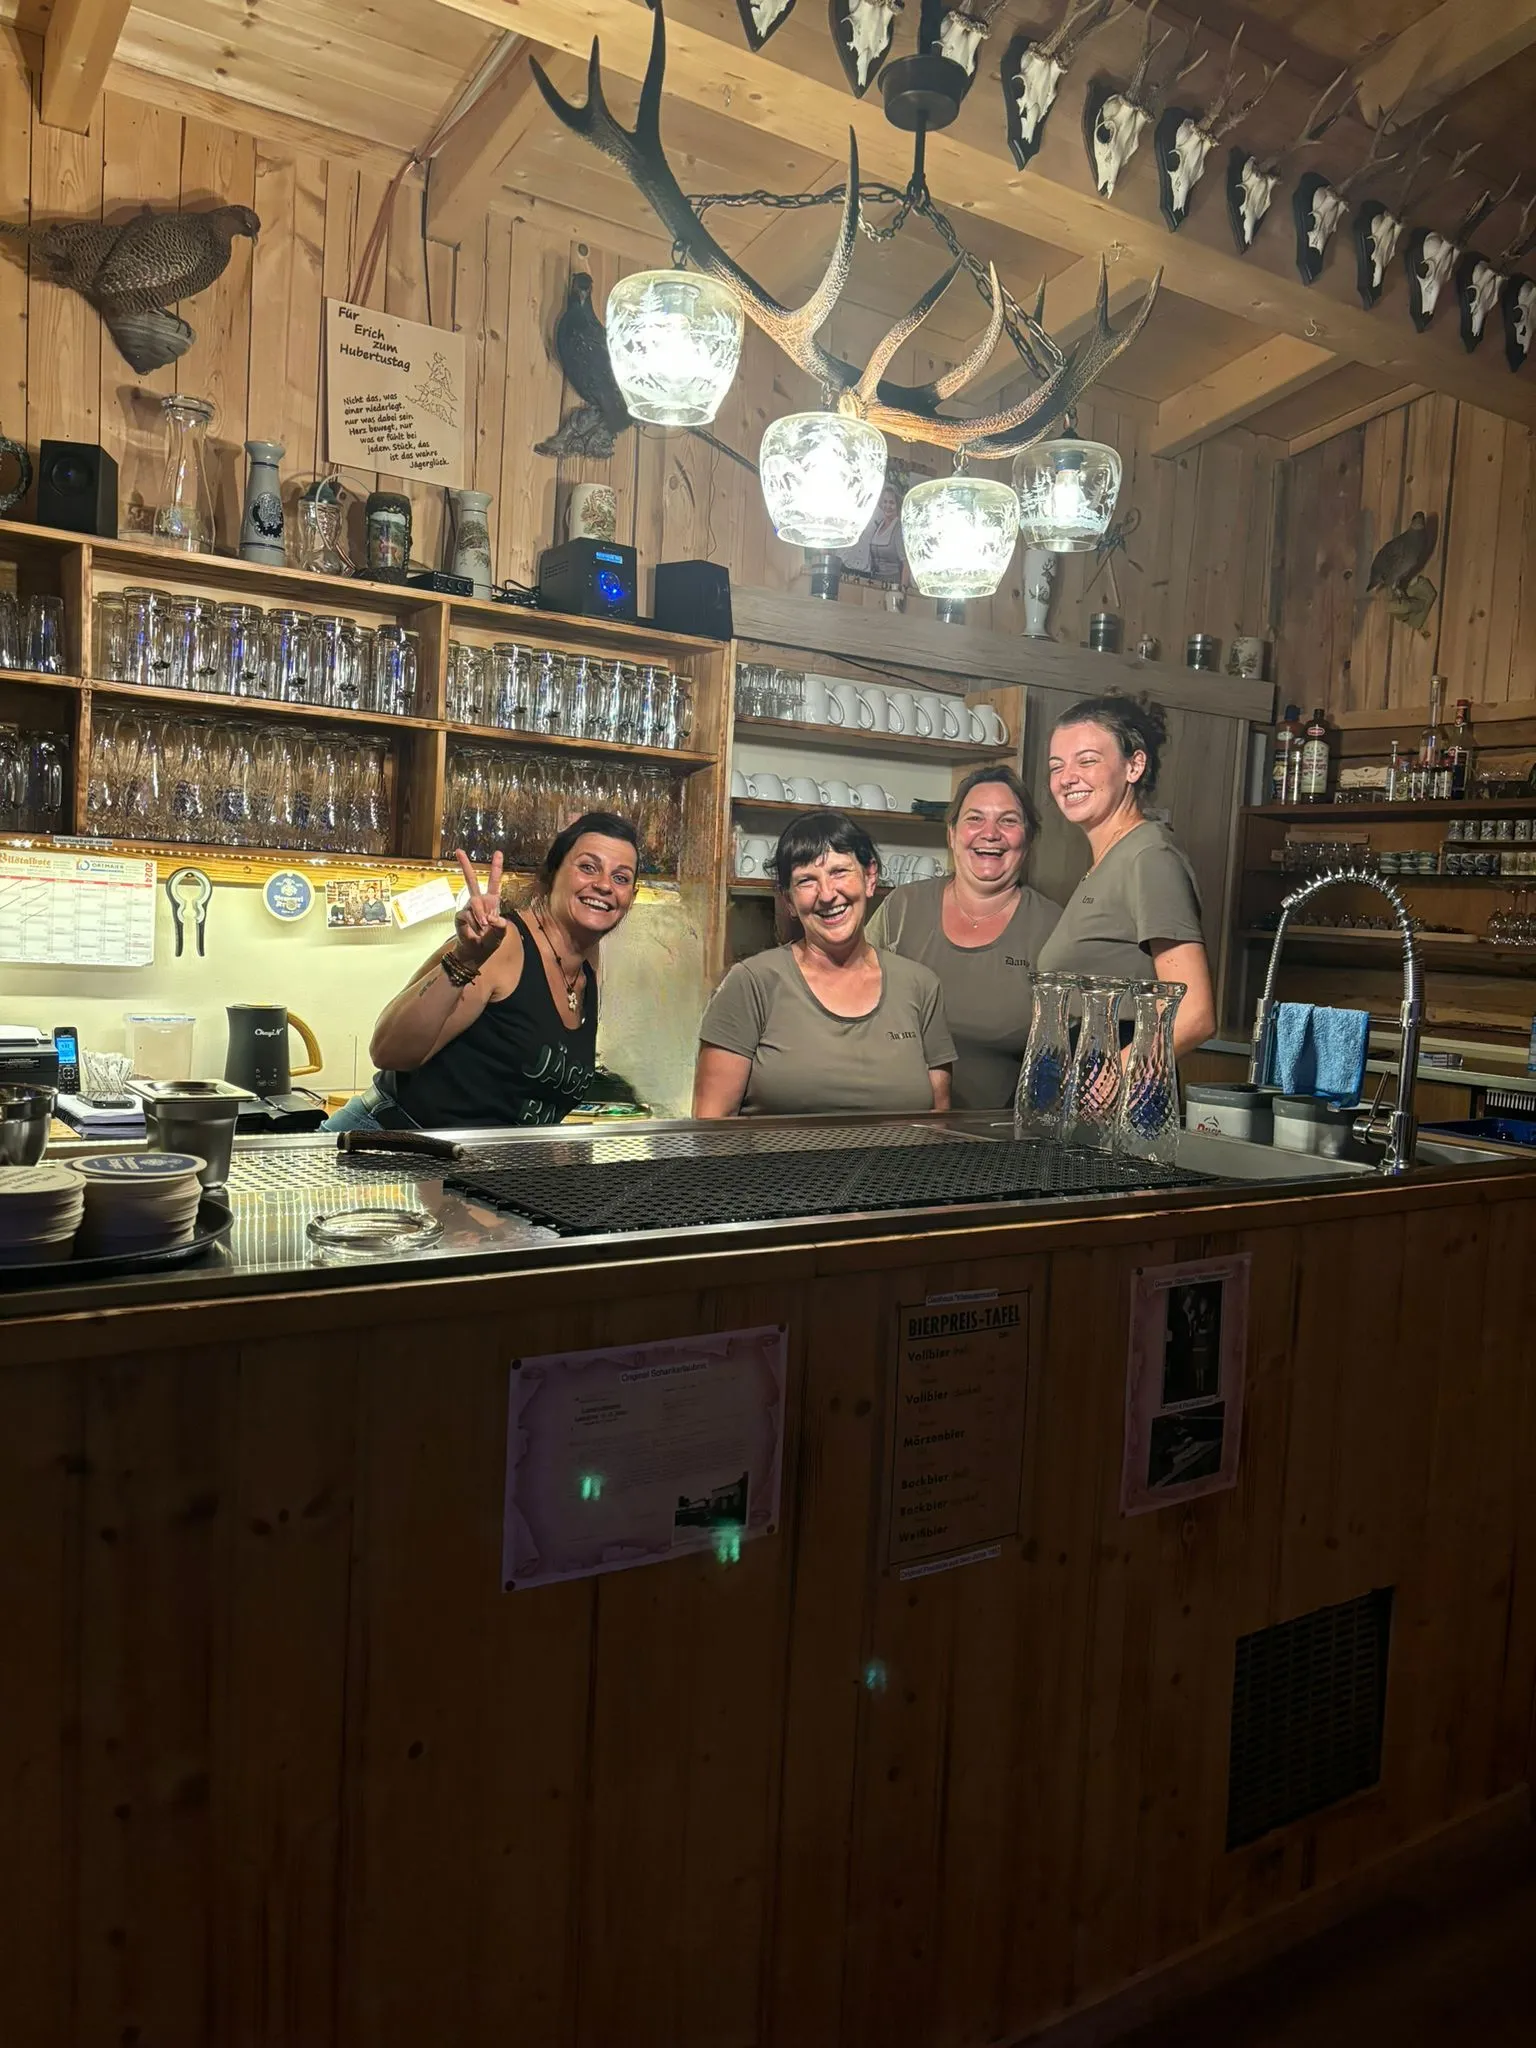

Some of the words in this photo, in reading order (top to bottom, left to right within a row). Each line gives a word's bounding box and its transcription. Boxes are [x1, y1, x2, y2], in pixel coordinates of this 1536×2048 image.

[338, 306, 360, 321] Für
[354, 324, 385, 341] Erich
[372, 340, 398, 354] zum
[340, 343, 411, 372] Hubertustag
[343, 394, 364, 405] Nicht
[344, 405, 364, 415] einer
[344, 417, 359, 426] nur
[360, 416, 376, 424] was
[377, 413, 398, 422] dabei
[399, 412, 414, 421] sein
[349, 426, 368, 436] Herz
[400, 422, 414, 430] nur
[360, 436, 375, 444] was
[376, 435, 384, 443] er
[386, 431, 405, 442] fühlt
[406, 431, 418, 440] bei
[367, 444, 391, 456] jedem
[418, 440, 430, 448] das
[390, 452, 400, 462] ist
[401, 451, 414, 460] das
[416, 449, 438, 458] wahre
[409, 458, 450, 470] Jägerglück.
[144, 862, 154, 883] 2024
[908, 1304, 1021, 1337] BIERPREIS-TAFEL
[908, 1347, 950, 1362] Vollbier
[906, 1390, 948, 1404] Vollbier
[903, 1429, 966, 1448] Märzenbier
[901, 1474, 950, 1490] Bockbier
[900, 1500, 949, 1516] Bockbier
[898, 1525, 949, 1543] Weißbier
